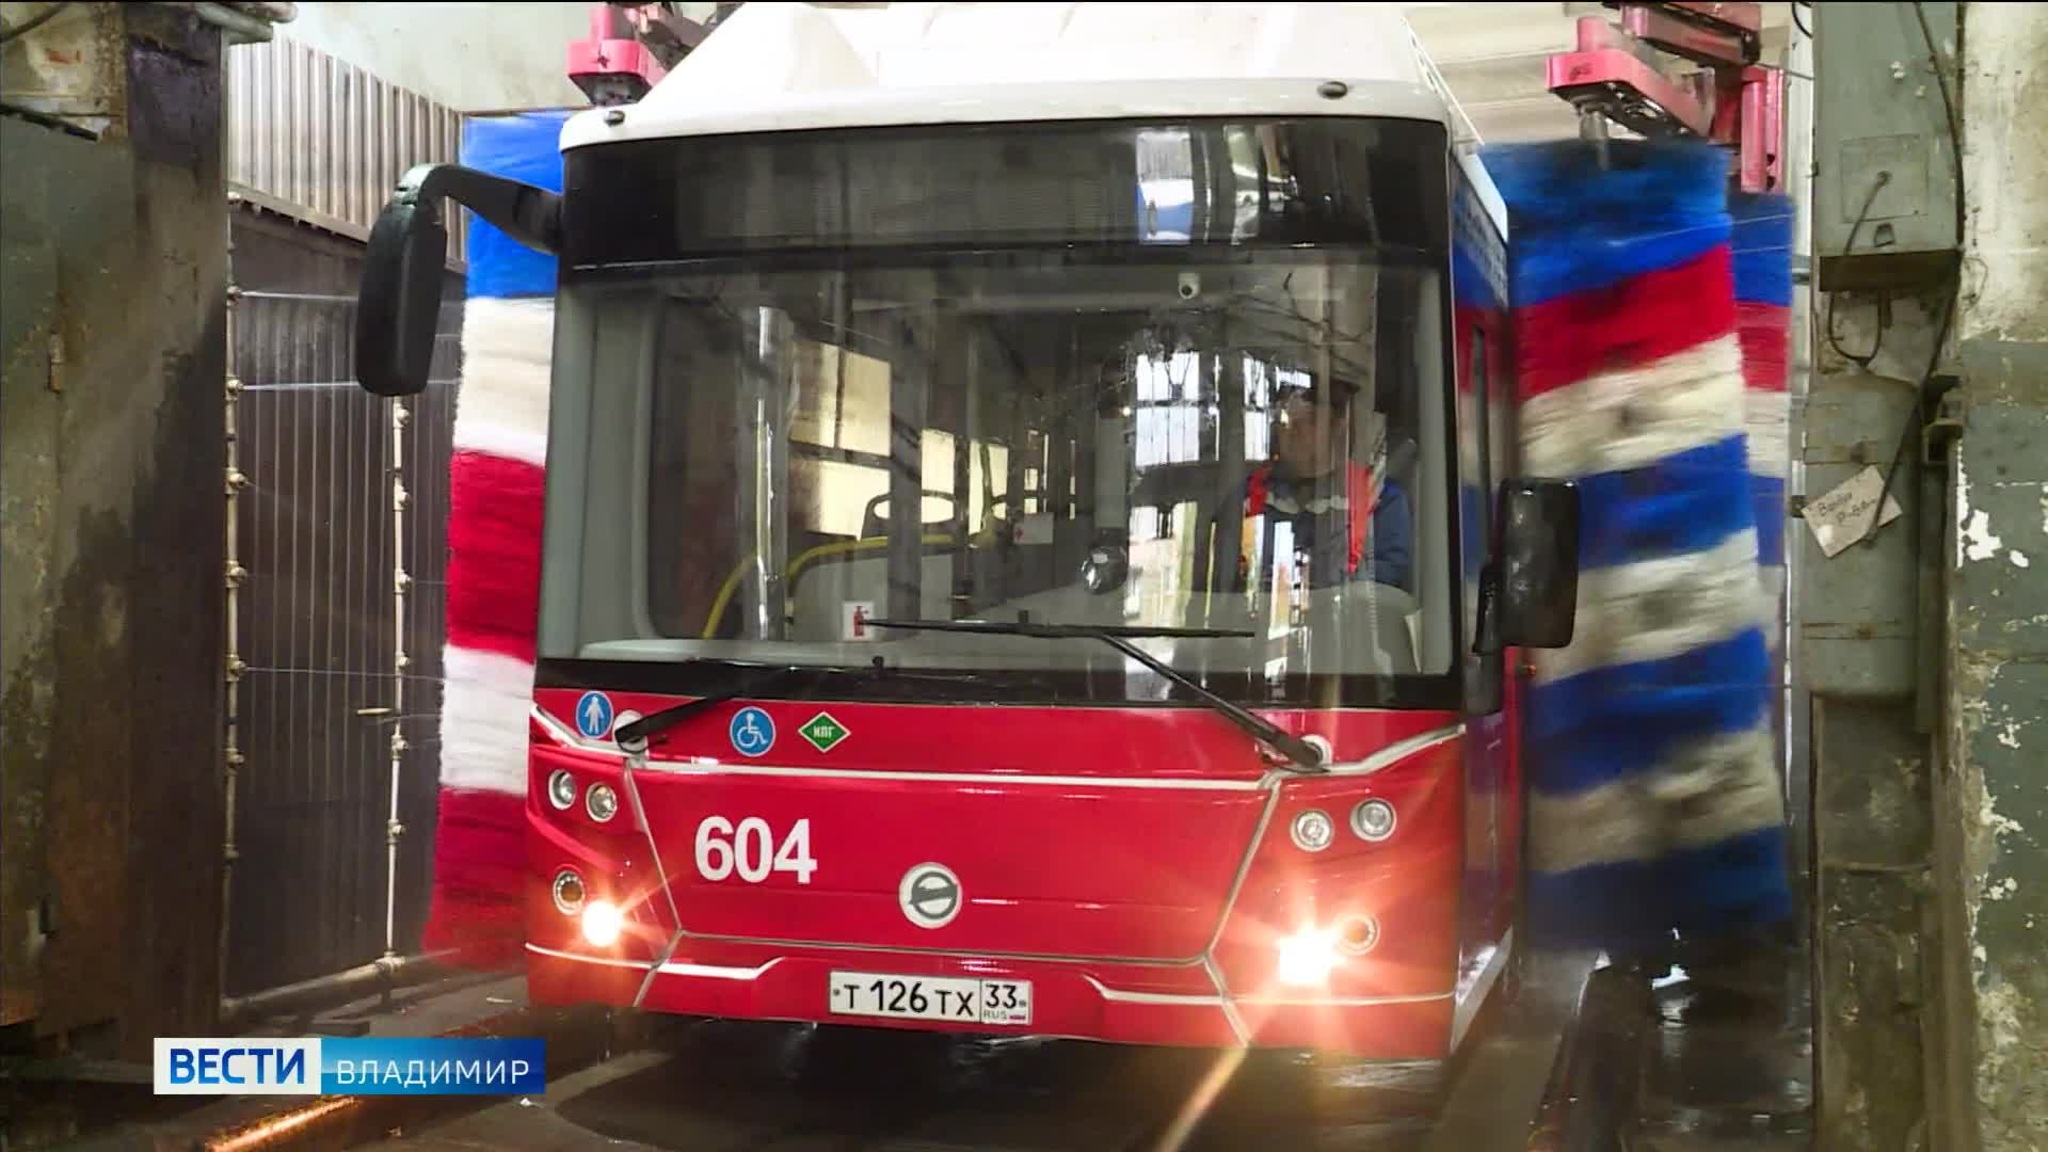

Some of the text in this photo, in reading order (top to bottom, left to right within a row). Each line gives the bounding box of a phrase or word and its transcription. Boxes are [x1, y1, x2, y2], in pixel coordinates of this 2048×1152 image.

[695, 815, 818, 884] 604
[870, 980, 928, 1013] 126
[985, 984, 1017, 1009] 33
[983, 1009, 1007, 1020] RUS
